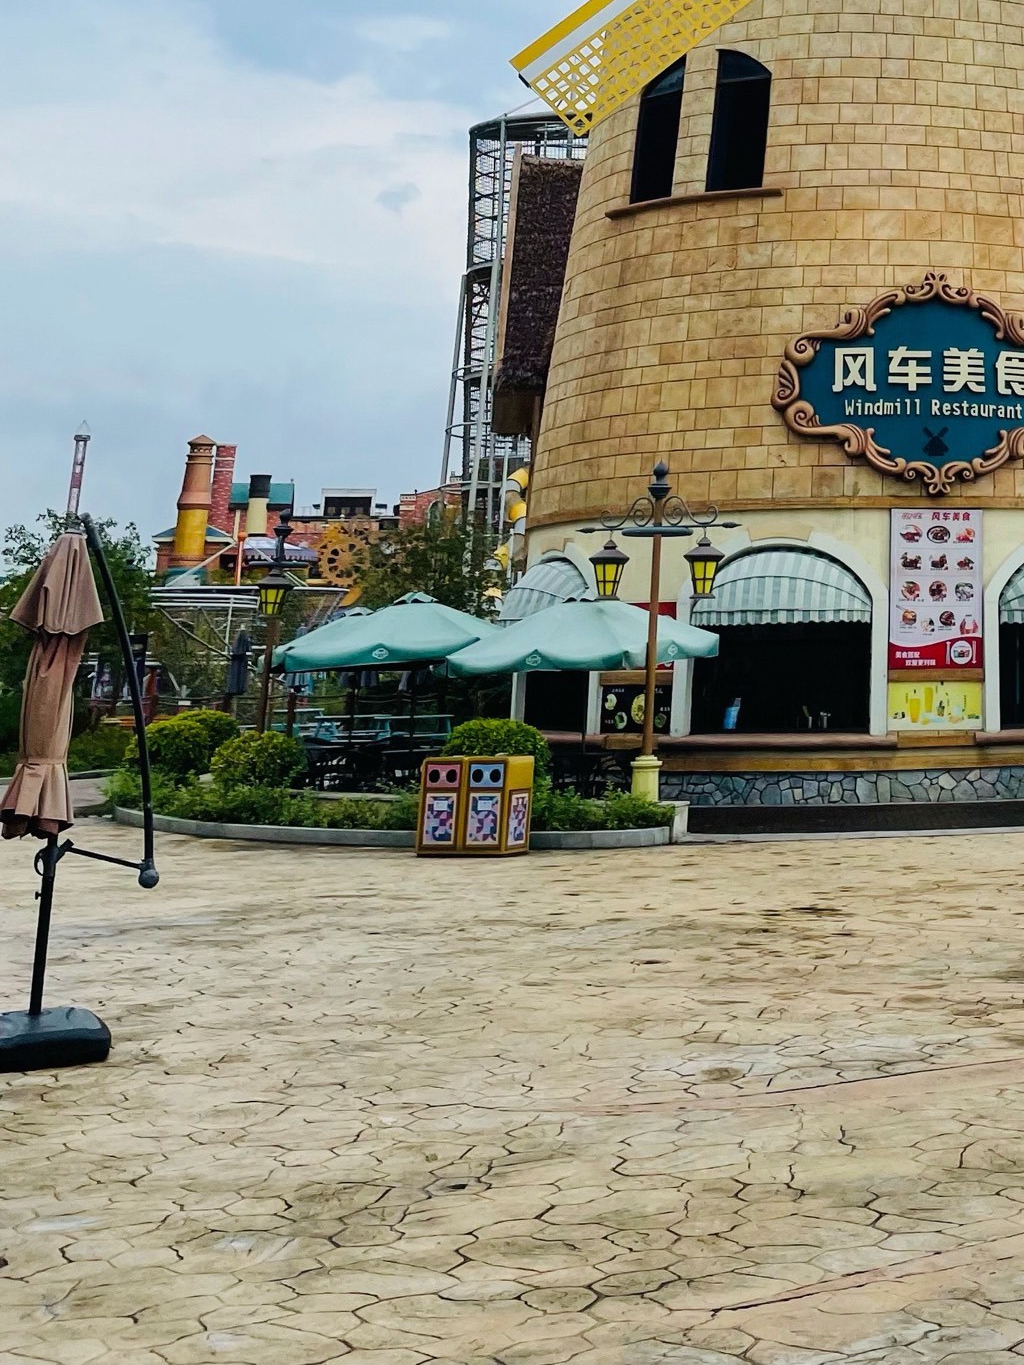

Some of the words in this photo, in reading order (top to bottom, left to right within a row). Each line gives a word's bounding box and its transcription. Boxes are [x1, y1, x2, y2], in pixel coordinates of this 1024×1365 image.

[844, 398, 921, 416] Windmill
[931, 399, 1023, 419] Restaurant
[931, 511, 971, 521] 风车美食
